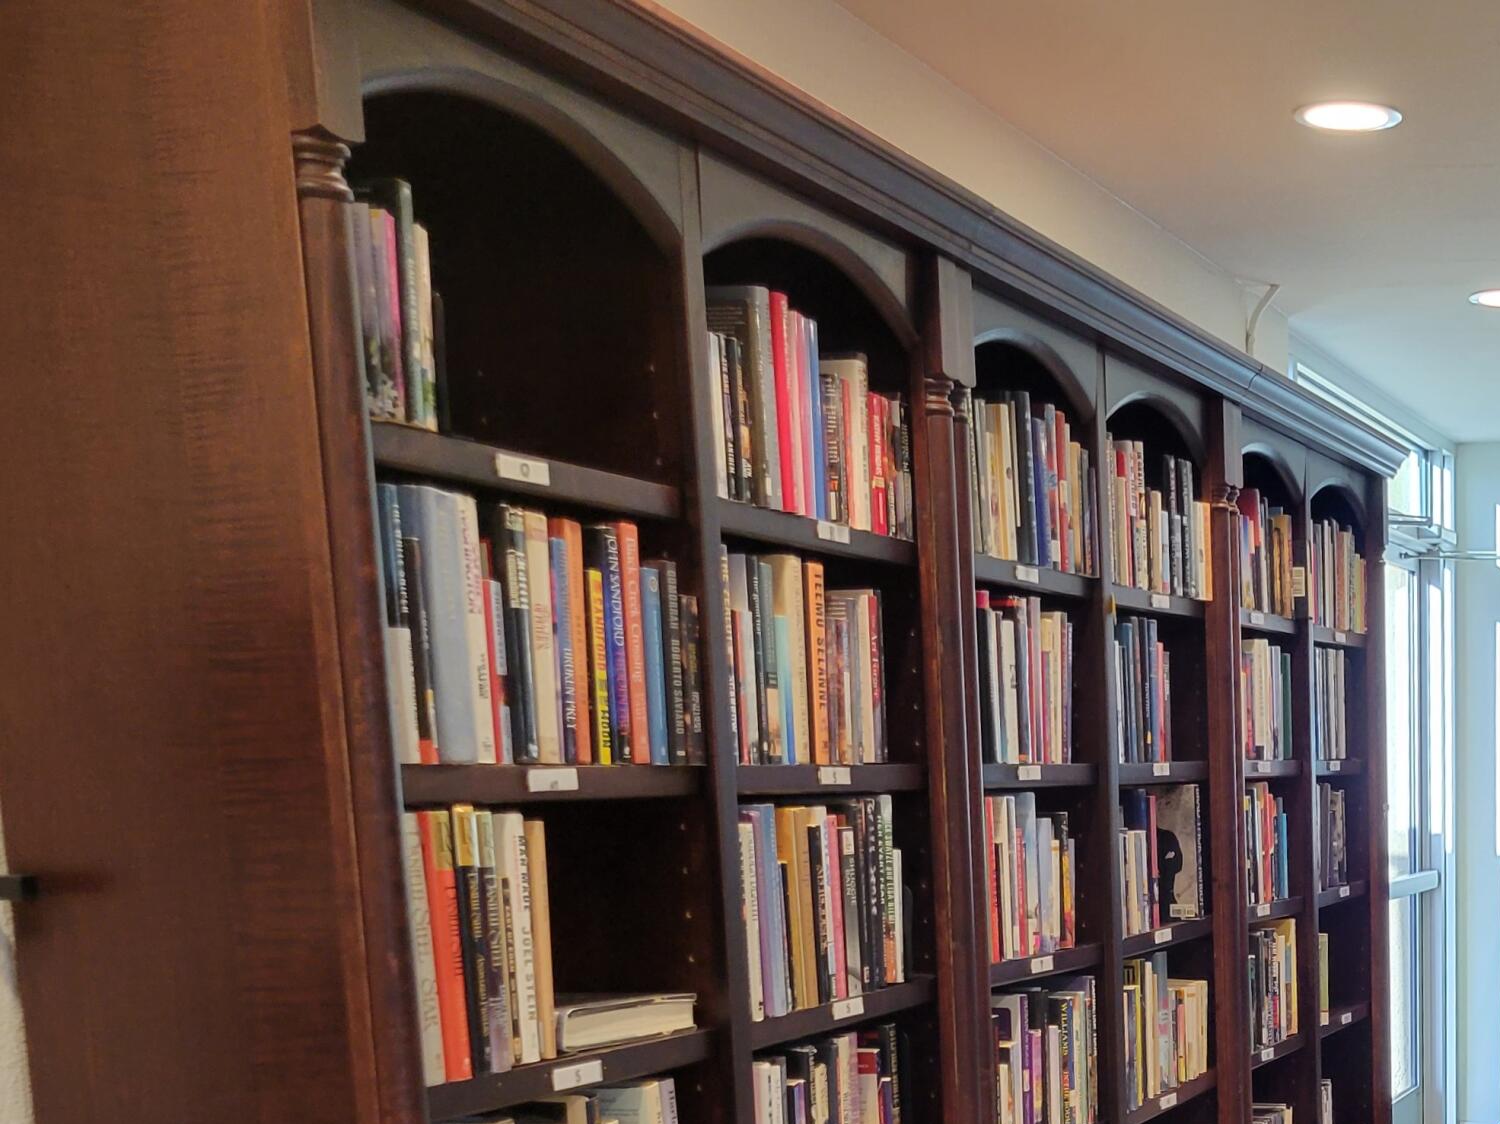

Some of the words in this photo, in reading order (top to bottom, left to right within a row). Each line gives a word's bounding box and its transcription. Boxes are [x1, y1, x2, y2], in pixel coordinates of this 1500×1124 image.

[604, 534, 618, 570] JOHN
[625, 537, 638, 575] Black
[608, 575, 625, 646] SANDFORD
[628, 580, 640, 619] Creek
[666, 569, 680, 630] GOMORRAH
[813, 573, 827, 630] TEEMU
[629, 624, 645, 684] Crossing
[670, 639, 683, 687] ROBERTO
[673, 689, 686, 736] SAVIANO
[521, 926, 534, 968] JOEL
[525, 973, 538, 1022] STEIN
[1059, 1002, 1070, 1057] WILLIAMS
